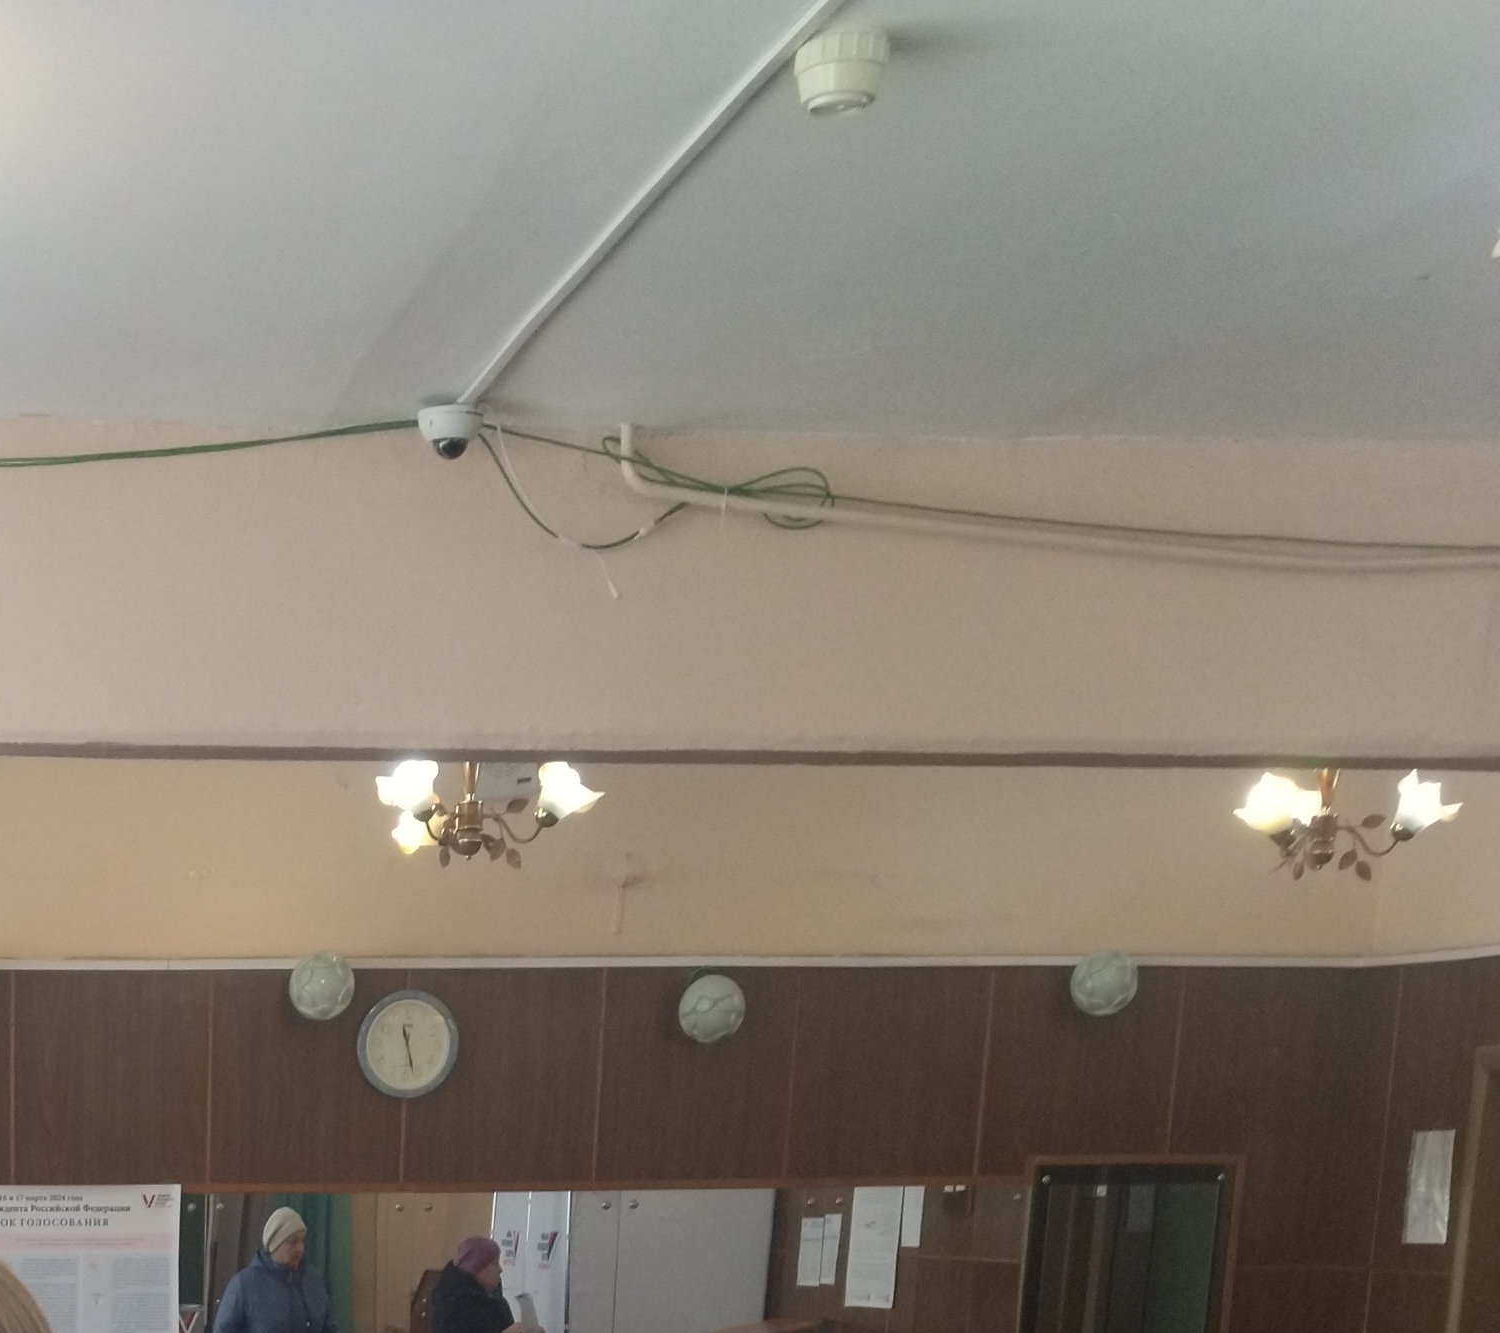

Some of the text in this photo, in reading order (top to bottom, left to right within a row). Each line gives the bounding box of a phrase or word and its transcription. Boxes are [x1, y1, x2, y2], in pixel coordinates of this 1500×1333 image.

[30, 1203, 80, 1212] Российской
[82, 1204, 131, 1214] Федерации
[20, 1218, 109, 1227] ГОЛОСОВАНИЯ
